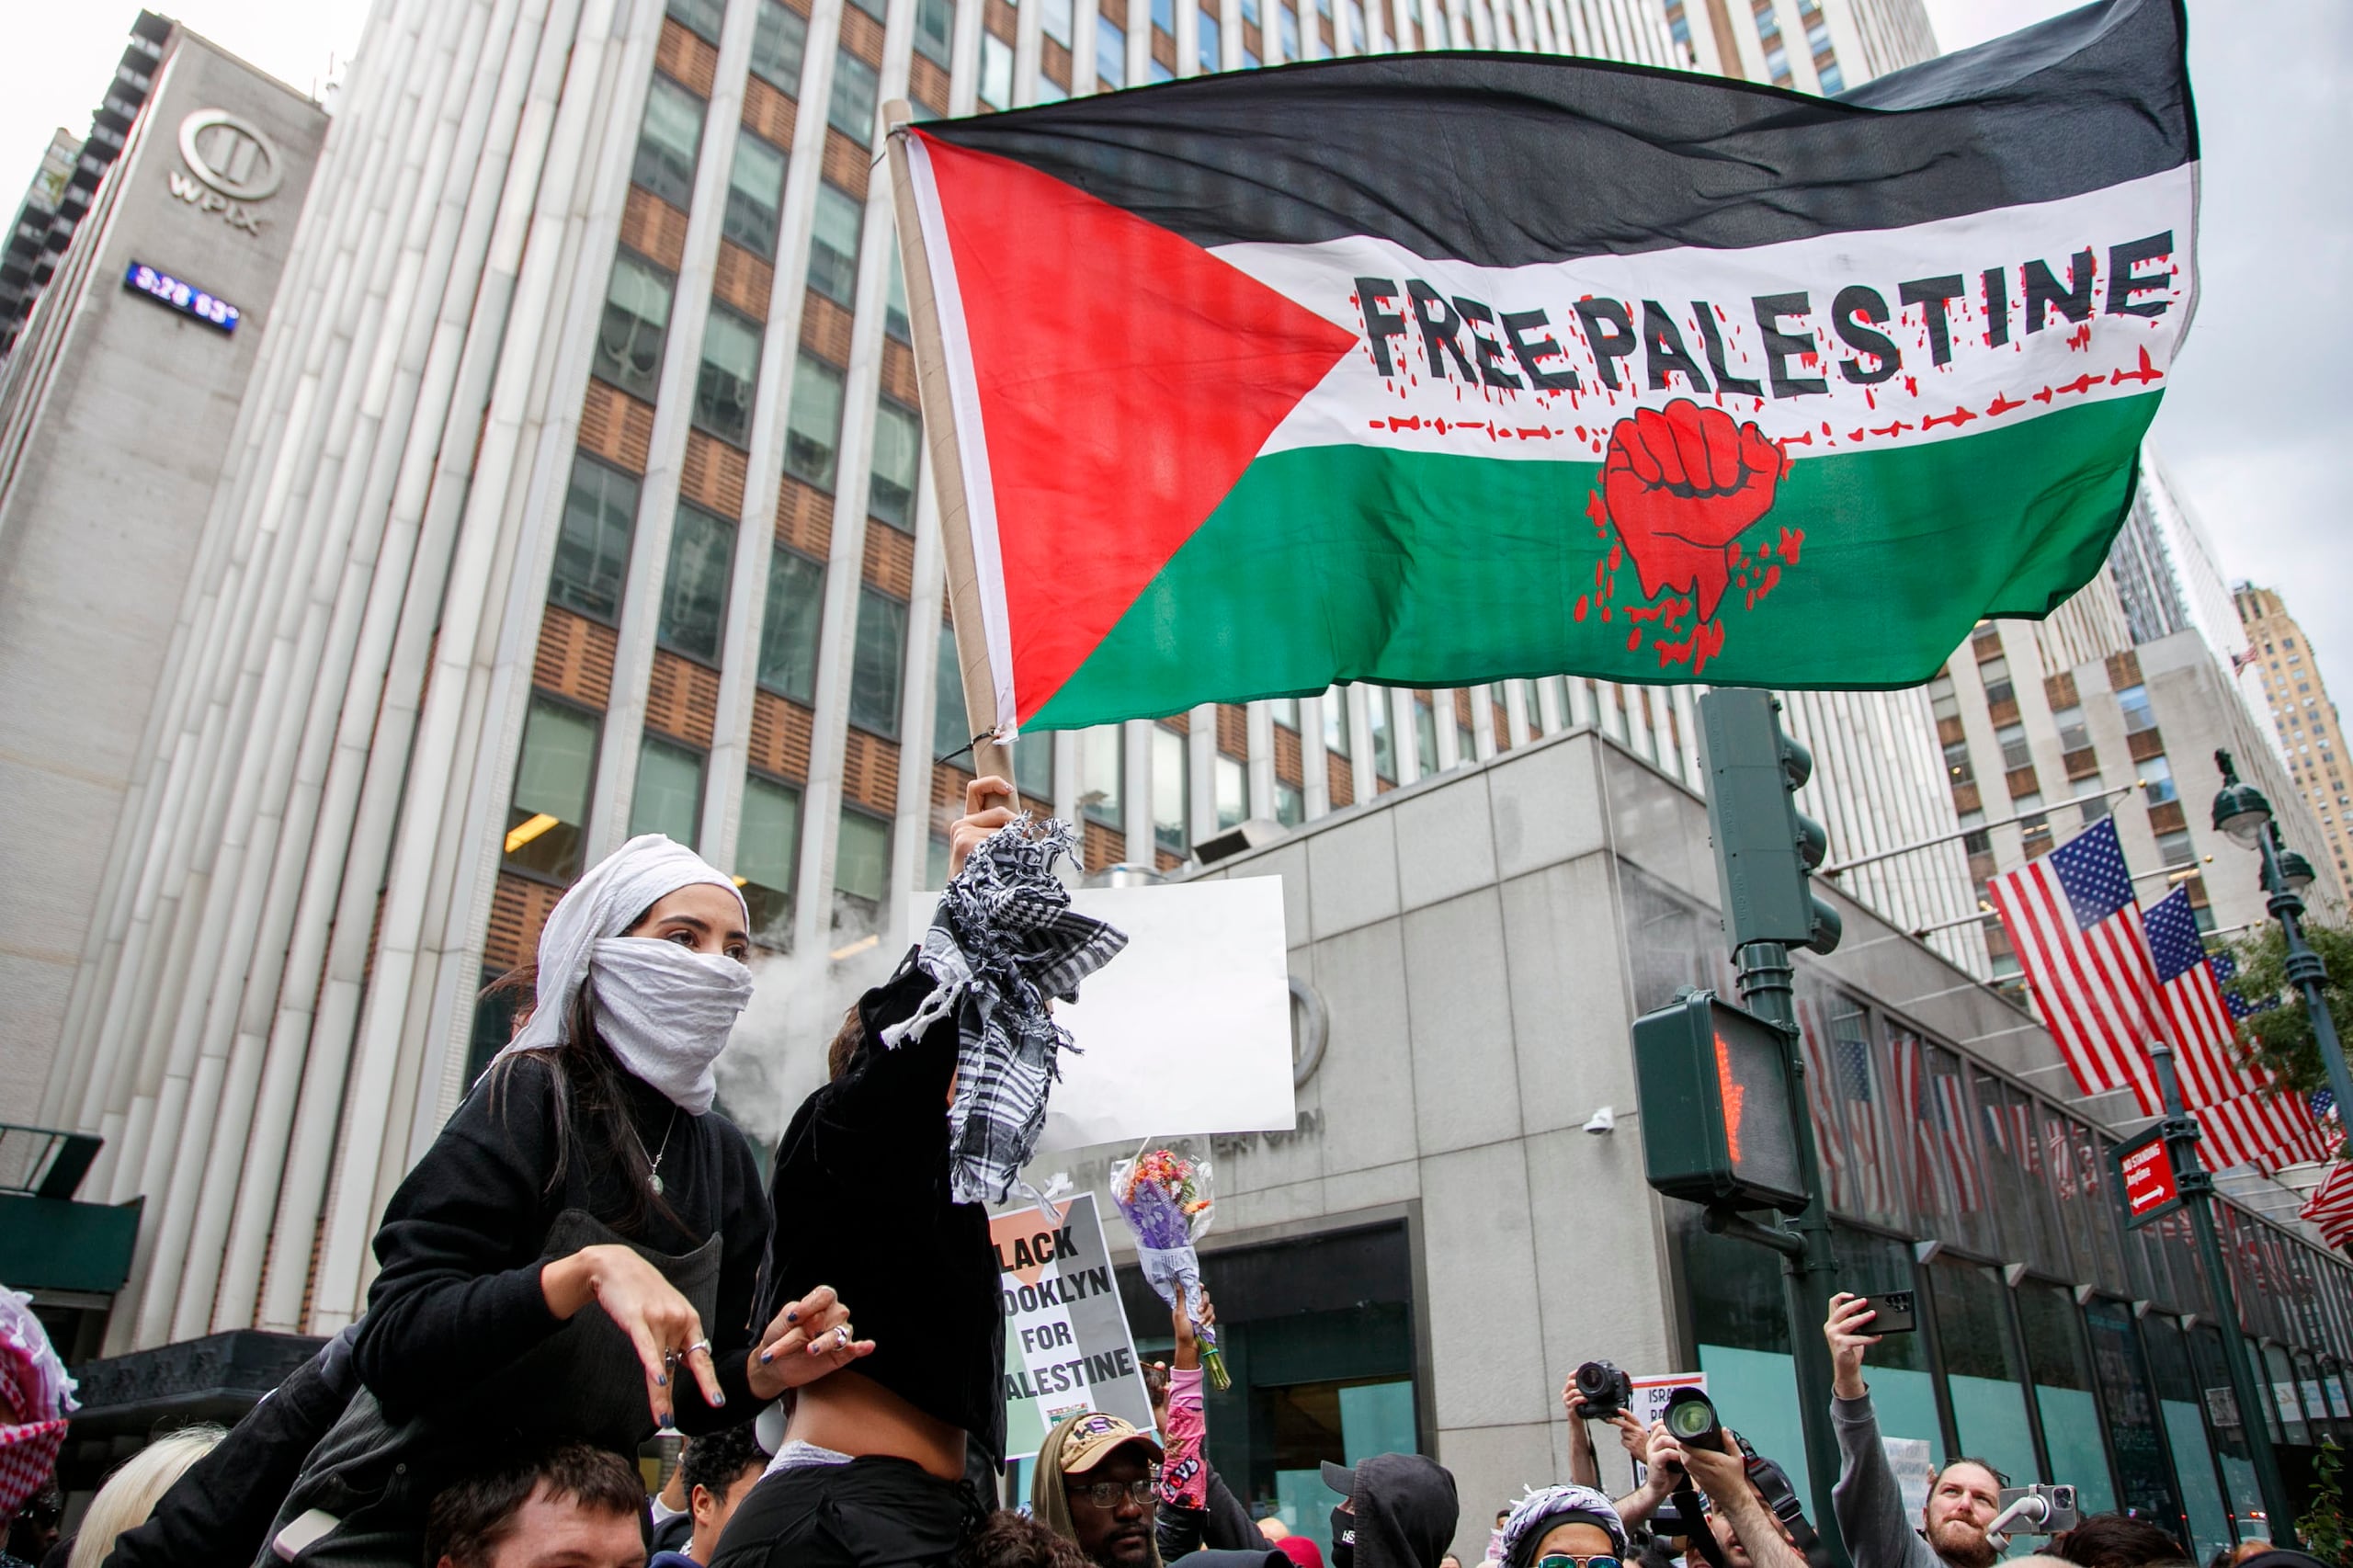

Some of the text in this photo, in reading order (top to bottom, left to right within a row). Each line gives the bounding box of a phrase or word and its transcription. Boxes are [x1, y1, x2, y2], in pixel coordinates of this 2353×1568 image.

[169, 170, 258, 237] WPIX
[1353, 229, 2175, 399] FREE PALESTINE
[994, 1225, 1079, 1273] LACK
[1004, 1266, 1112, 1317] OOKLYN
[1020, 1321, 1074, 1354] FOR
[1005, 1346, 1135, 1401] ALESTINE
[1165, 1455, 1199, 1498] LOVE
